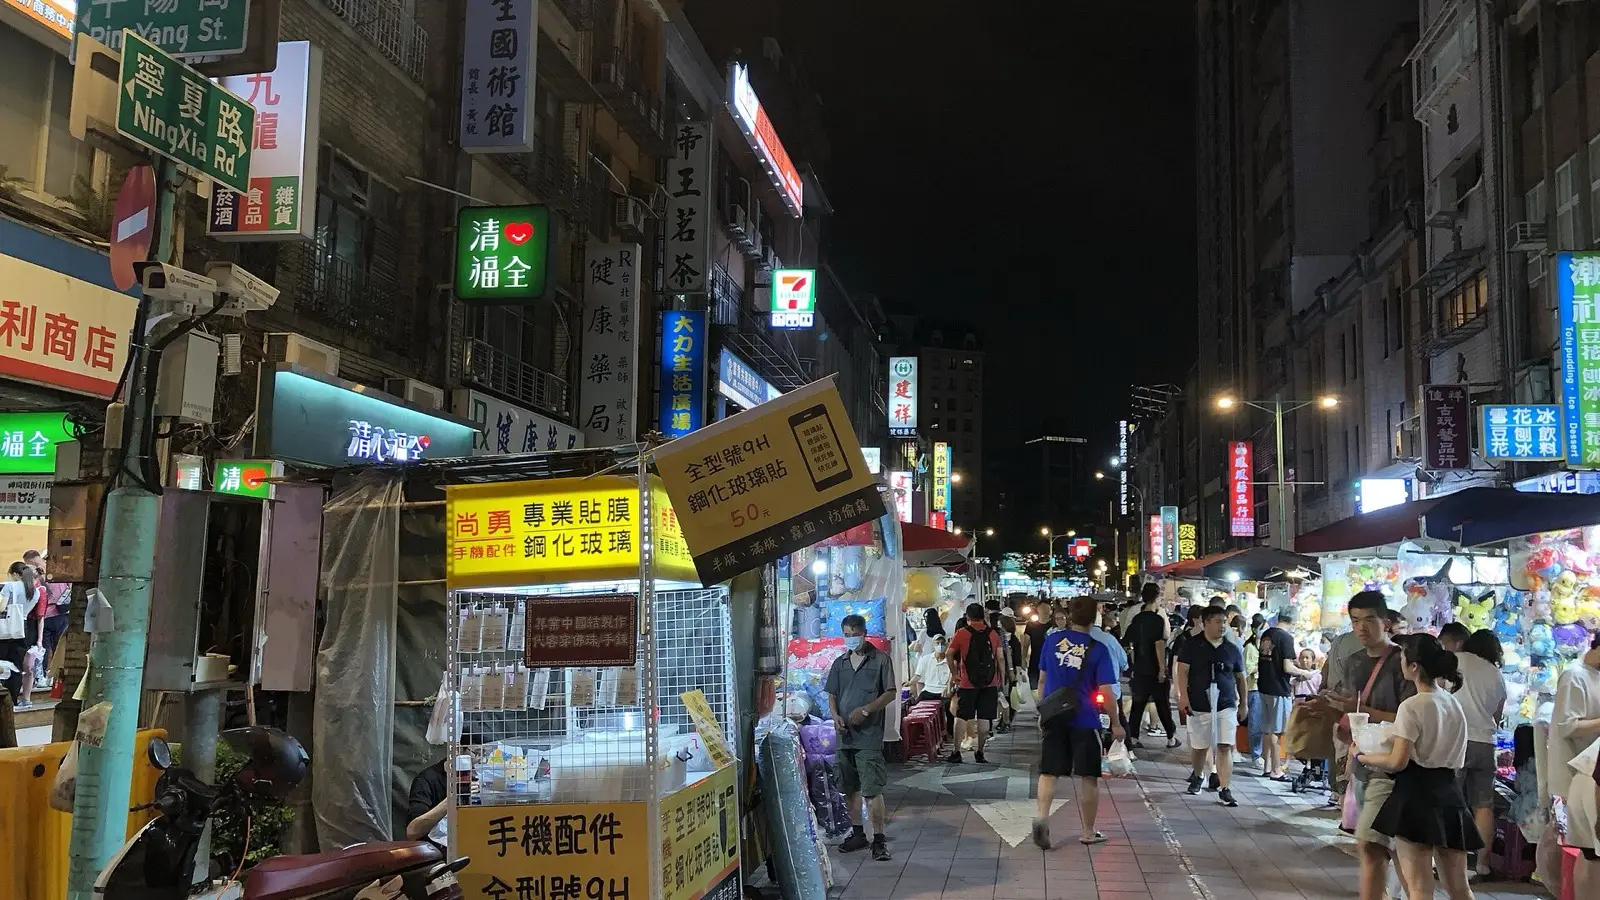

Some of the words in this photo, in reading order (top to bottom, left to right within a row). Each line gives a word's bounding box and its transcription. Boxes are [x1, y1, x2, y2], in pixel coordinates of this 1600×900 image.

[90, 22, 189, 52] PinYang
[197, 17, 228, 42] St.
[133, 52, 245, 148] 寧夏路
[247, 73, 280, 150] 九龍
[134, 101, 208, 163] NingXia
[213, 145, 237, 179] Rd.
[215, 188, 235, 226] 菸酒
[245, 187, 263, 225] 食品
[274, 186, 294, 226] 雜貨
[670, 125, 703, 288] 帝王茗茶
[470, 218, 500, 252] 清
[469, 256, 532, 289] 福全
[617, 271, 631, 342] 台北醫學院
[0, 301, 117, 372] 利商店
[585, 256, 615, 433] 健康藥局
[1565, 326, 1574, 346] Tofu
[670, 315, 694, 431] 大力生活廣場
[1565, 347, 1576, 384] pudding
[894, 379, 913, 425] 建祥
[1489, 408, 1556, 425] 雪花冰
[1, 430, 50, 457] 福全
[347, 420, 423, 461] 清心福全
[684, 433, 771, 484] 全型號9H
[1490, 427, 1510, 457] 豆花
[1514, 427, 1533, 457] 刨冰
[1538, 427, 1557, 457] 飲料
[1569, 422, 1579, 457] Dessert
[220, 466, 241, 491] 清
[687, 458, 788, 514] 鋼化玻璃貼
[936, 455, 945, 497] 小北百貨
[456, 509, 511, 537] 尚勇
[523, 496, 631, 528] 專業貼膜
[454, 543, 516, 560] 手機配件
[524, 529, 632, 559] 鋼化玻璃
[487, 812, 624, 857] 手機配件
